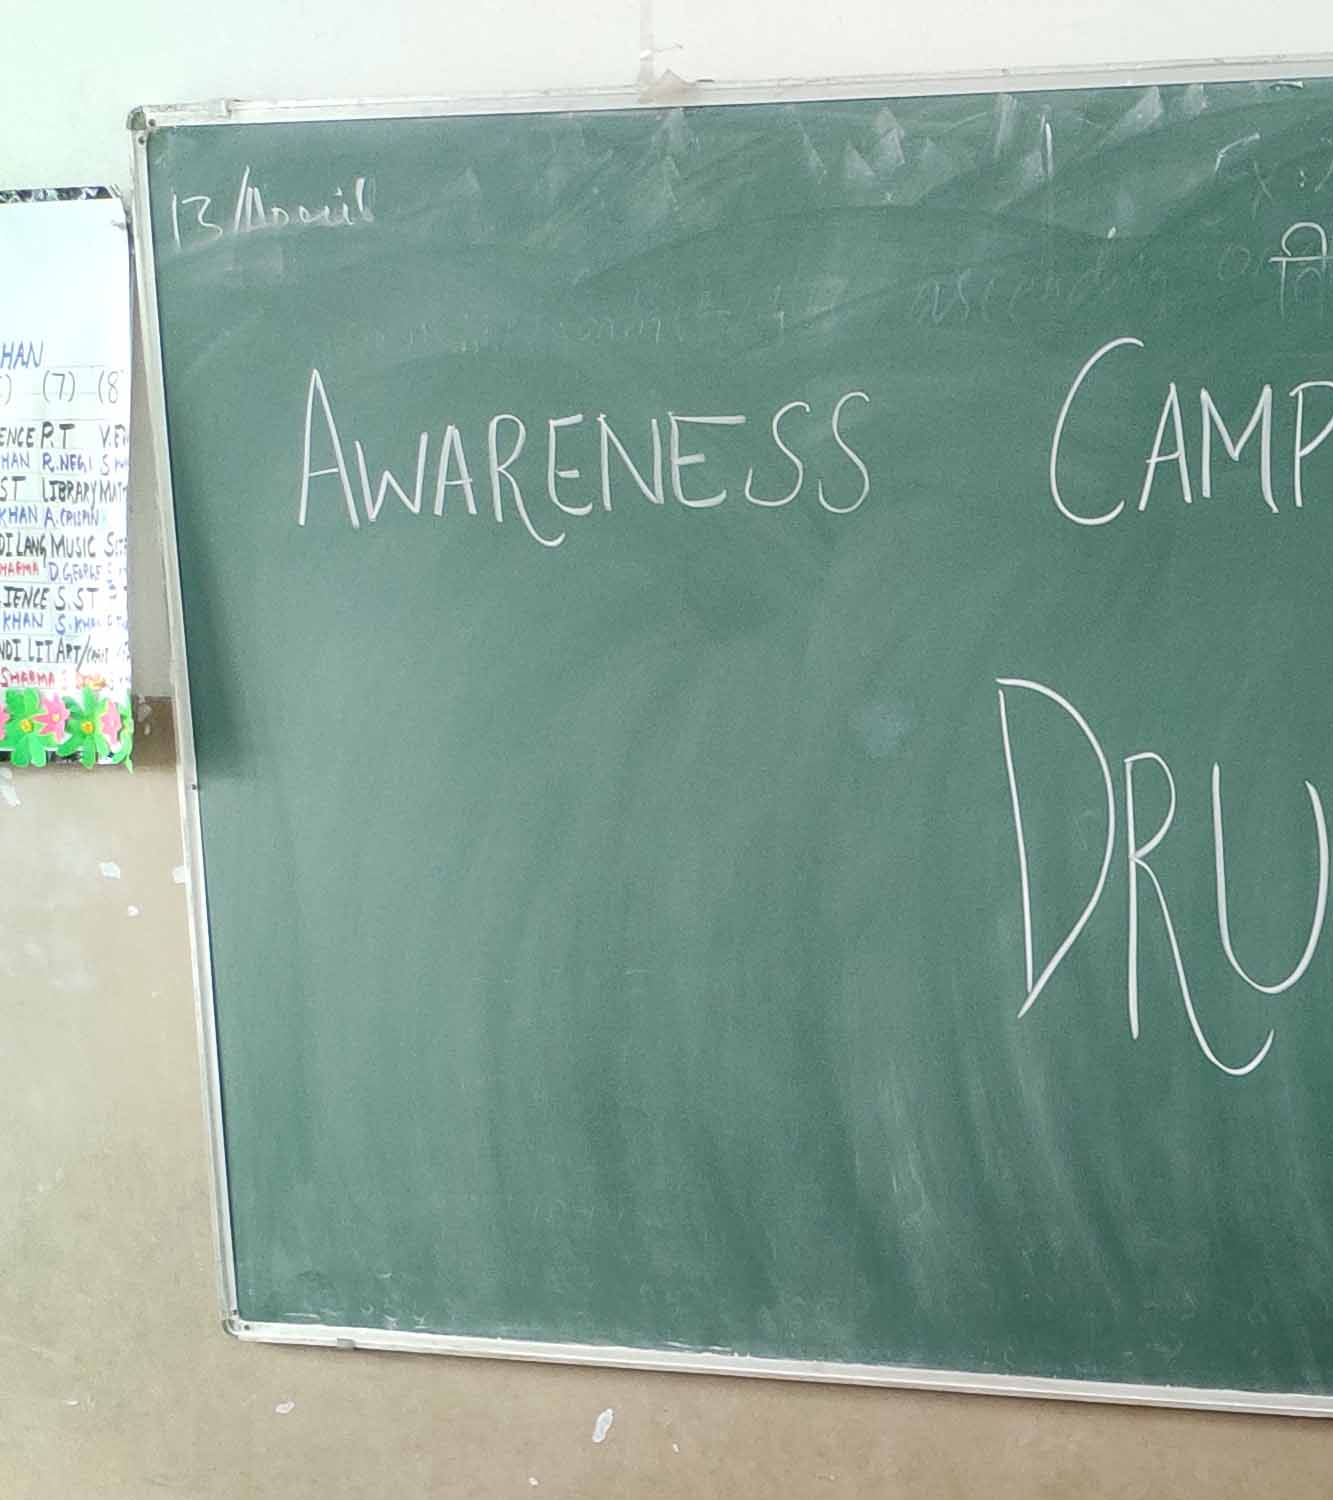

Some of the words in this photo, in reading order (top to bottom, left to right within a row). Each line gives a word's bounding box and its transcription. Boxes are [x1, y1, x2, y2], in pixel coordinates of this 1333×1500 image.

[42, 369, 76, 403] (7)
[299, 369, 871, 547] AWARENESS
[49, 531, 97, 558] MUSIC
